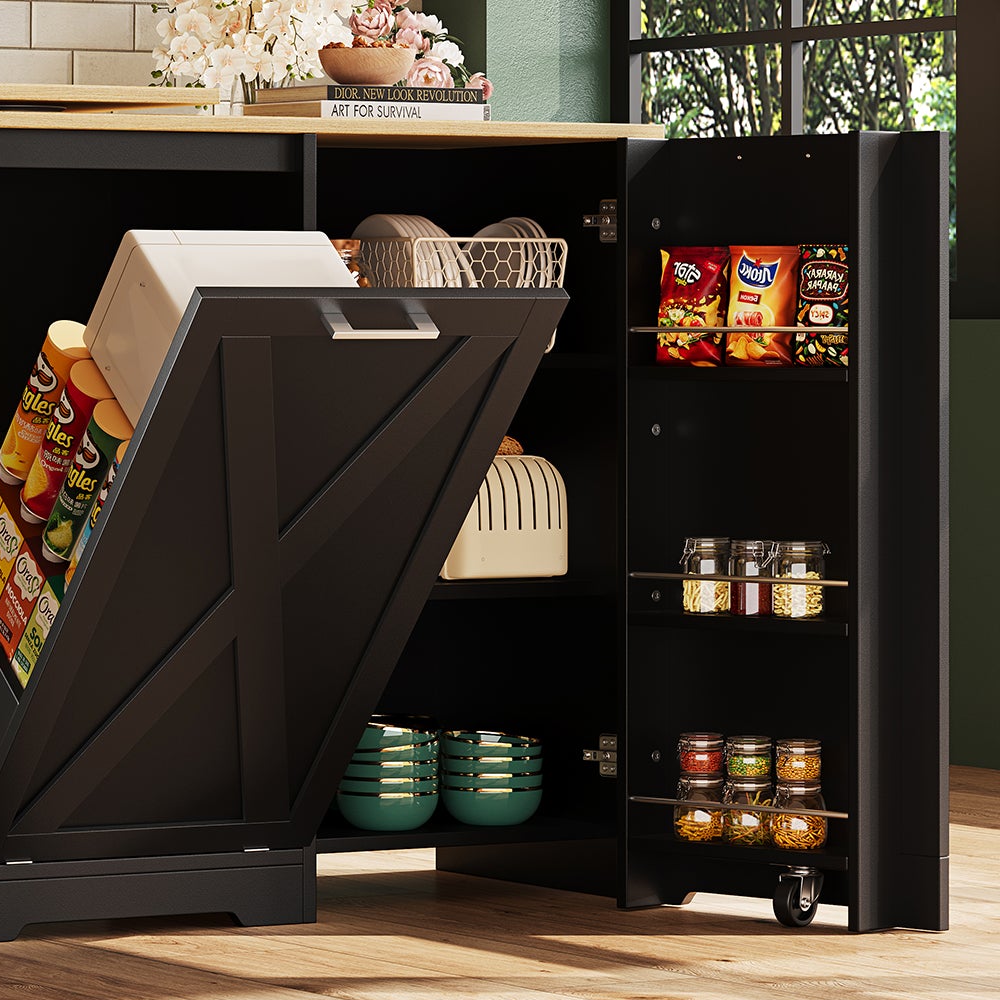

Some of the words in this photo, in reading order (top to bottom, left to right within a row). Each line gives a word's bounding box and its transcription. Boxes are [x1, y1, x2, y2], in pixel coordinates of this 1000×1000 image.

[334, 87, 361, 99] DIOR.
[363, 88, 387, 100] NEW
[388, 89, 413, 101] LOOK
[416, 89, 478, 102] REVOLUTION
[331, 104, 350, 117] ART
[354, 105, 374, 118] FOR
[377, 105, 422, 119] SURVIVAL
[6, 582, 28, 626] NOCCIOLA
